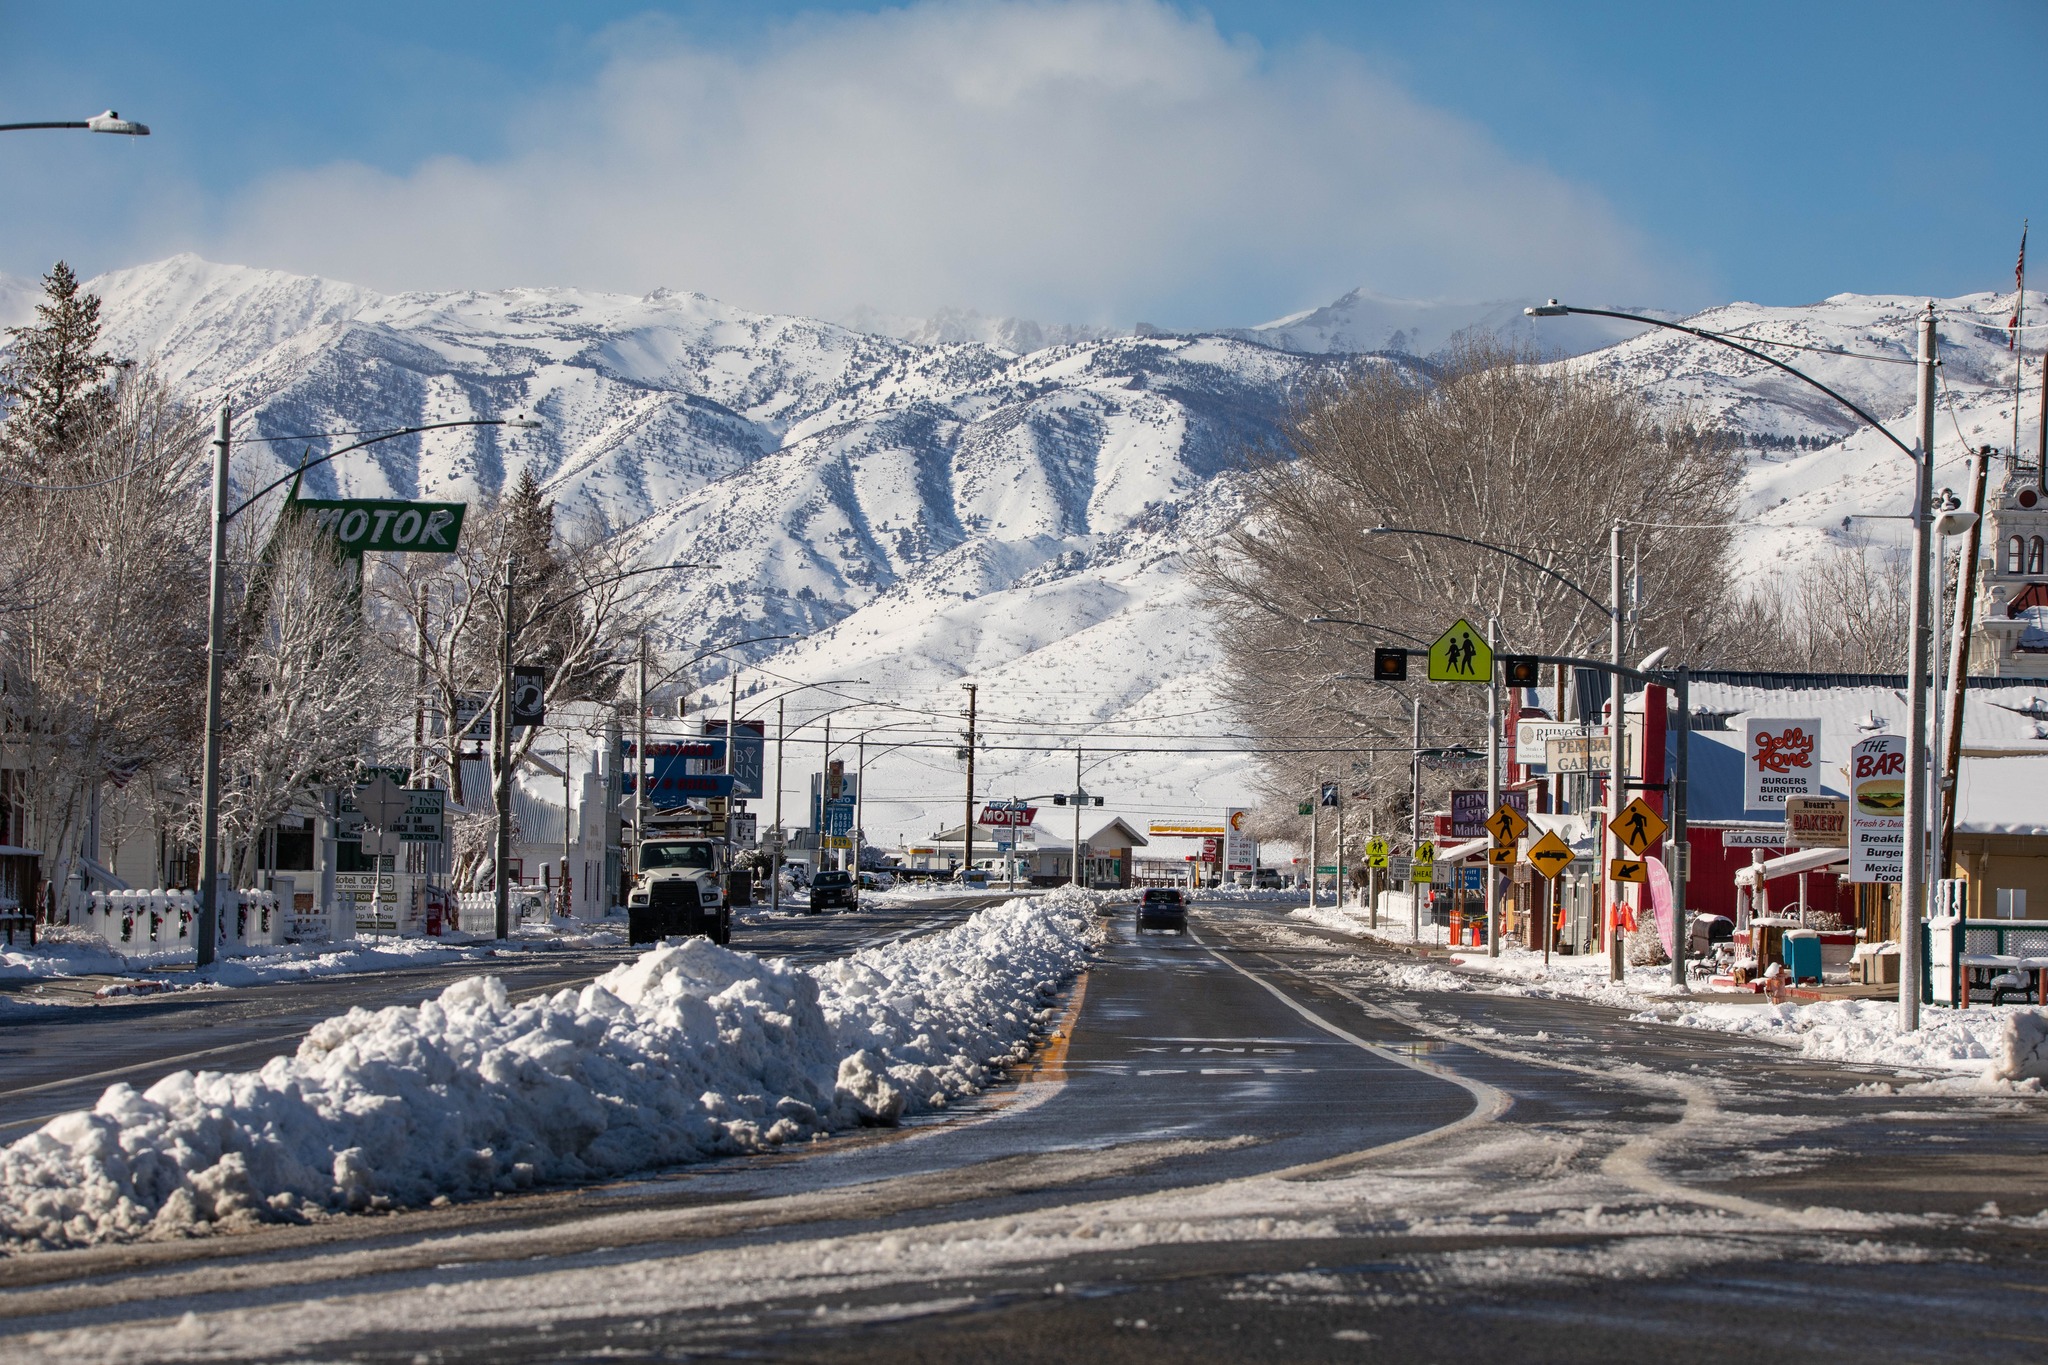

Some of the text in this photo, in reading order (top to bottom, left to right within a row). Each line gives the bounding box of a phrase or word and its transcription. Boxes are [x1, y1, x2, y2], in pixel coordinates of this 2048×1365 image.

[306, 508, 455, 545] MOTOR
[1558, 739, 1611, 754] PEMBA
[1755, 727, 1814, 753] Jolly
[1862, 740, 1889, 753] THE
[1558, 755, 1610, 770] GARAG
[1752, 748, 1813, 773] Kone
[1856, 752, 1906, 778] BAR
[1762, 777, 1807, 785] BURGERS
[1760, 786, 1808, 794] BURRITOS
[419, 797, 440, 806] INN
[1455, 793, 1525, 810] GENRAL
[983, 810, 1030, 823] MOTEL
[1793, 814, 1845, 832] BAKERY
[1455, 823, 1488, 836] Marke
[1879, 820, 1886, 828] &
[834, 838, 847, 846] 629
[1730, 835, 1786, 844] MASSAG
[1861, 834, 1904, 843] Breakfa
[1865, 863, 1903, 873] Mexica
[1875, 873, 1903, 882] Food
